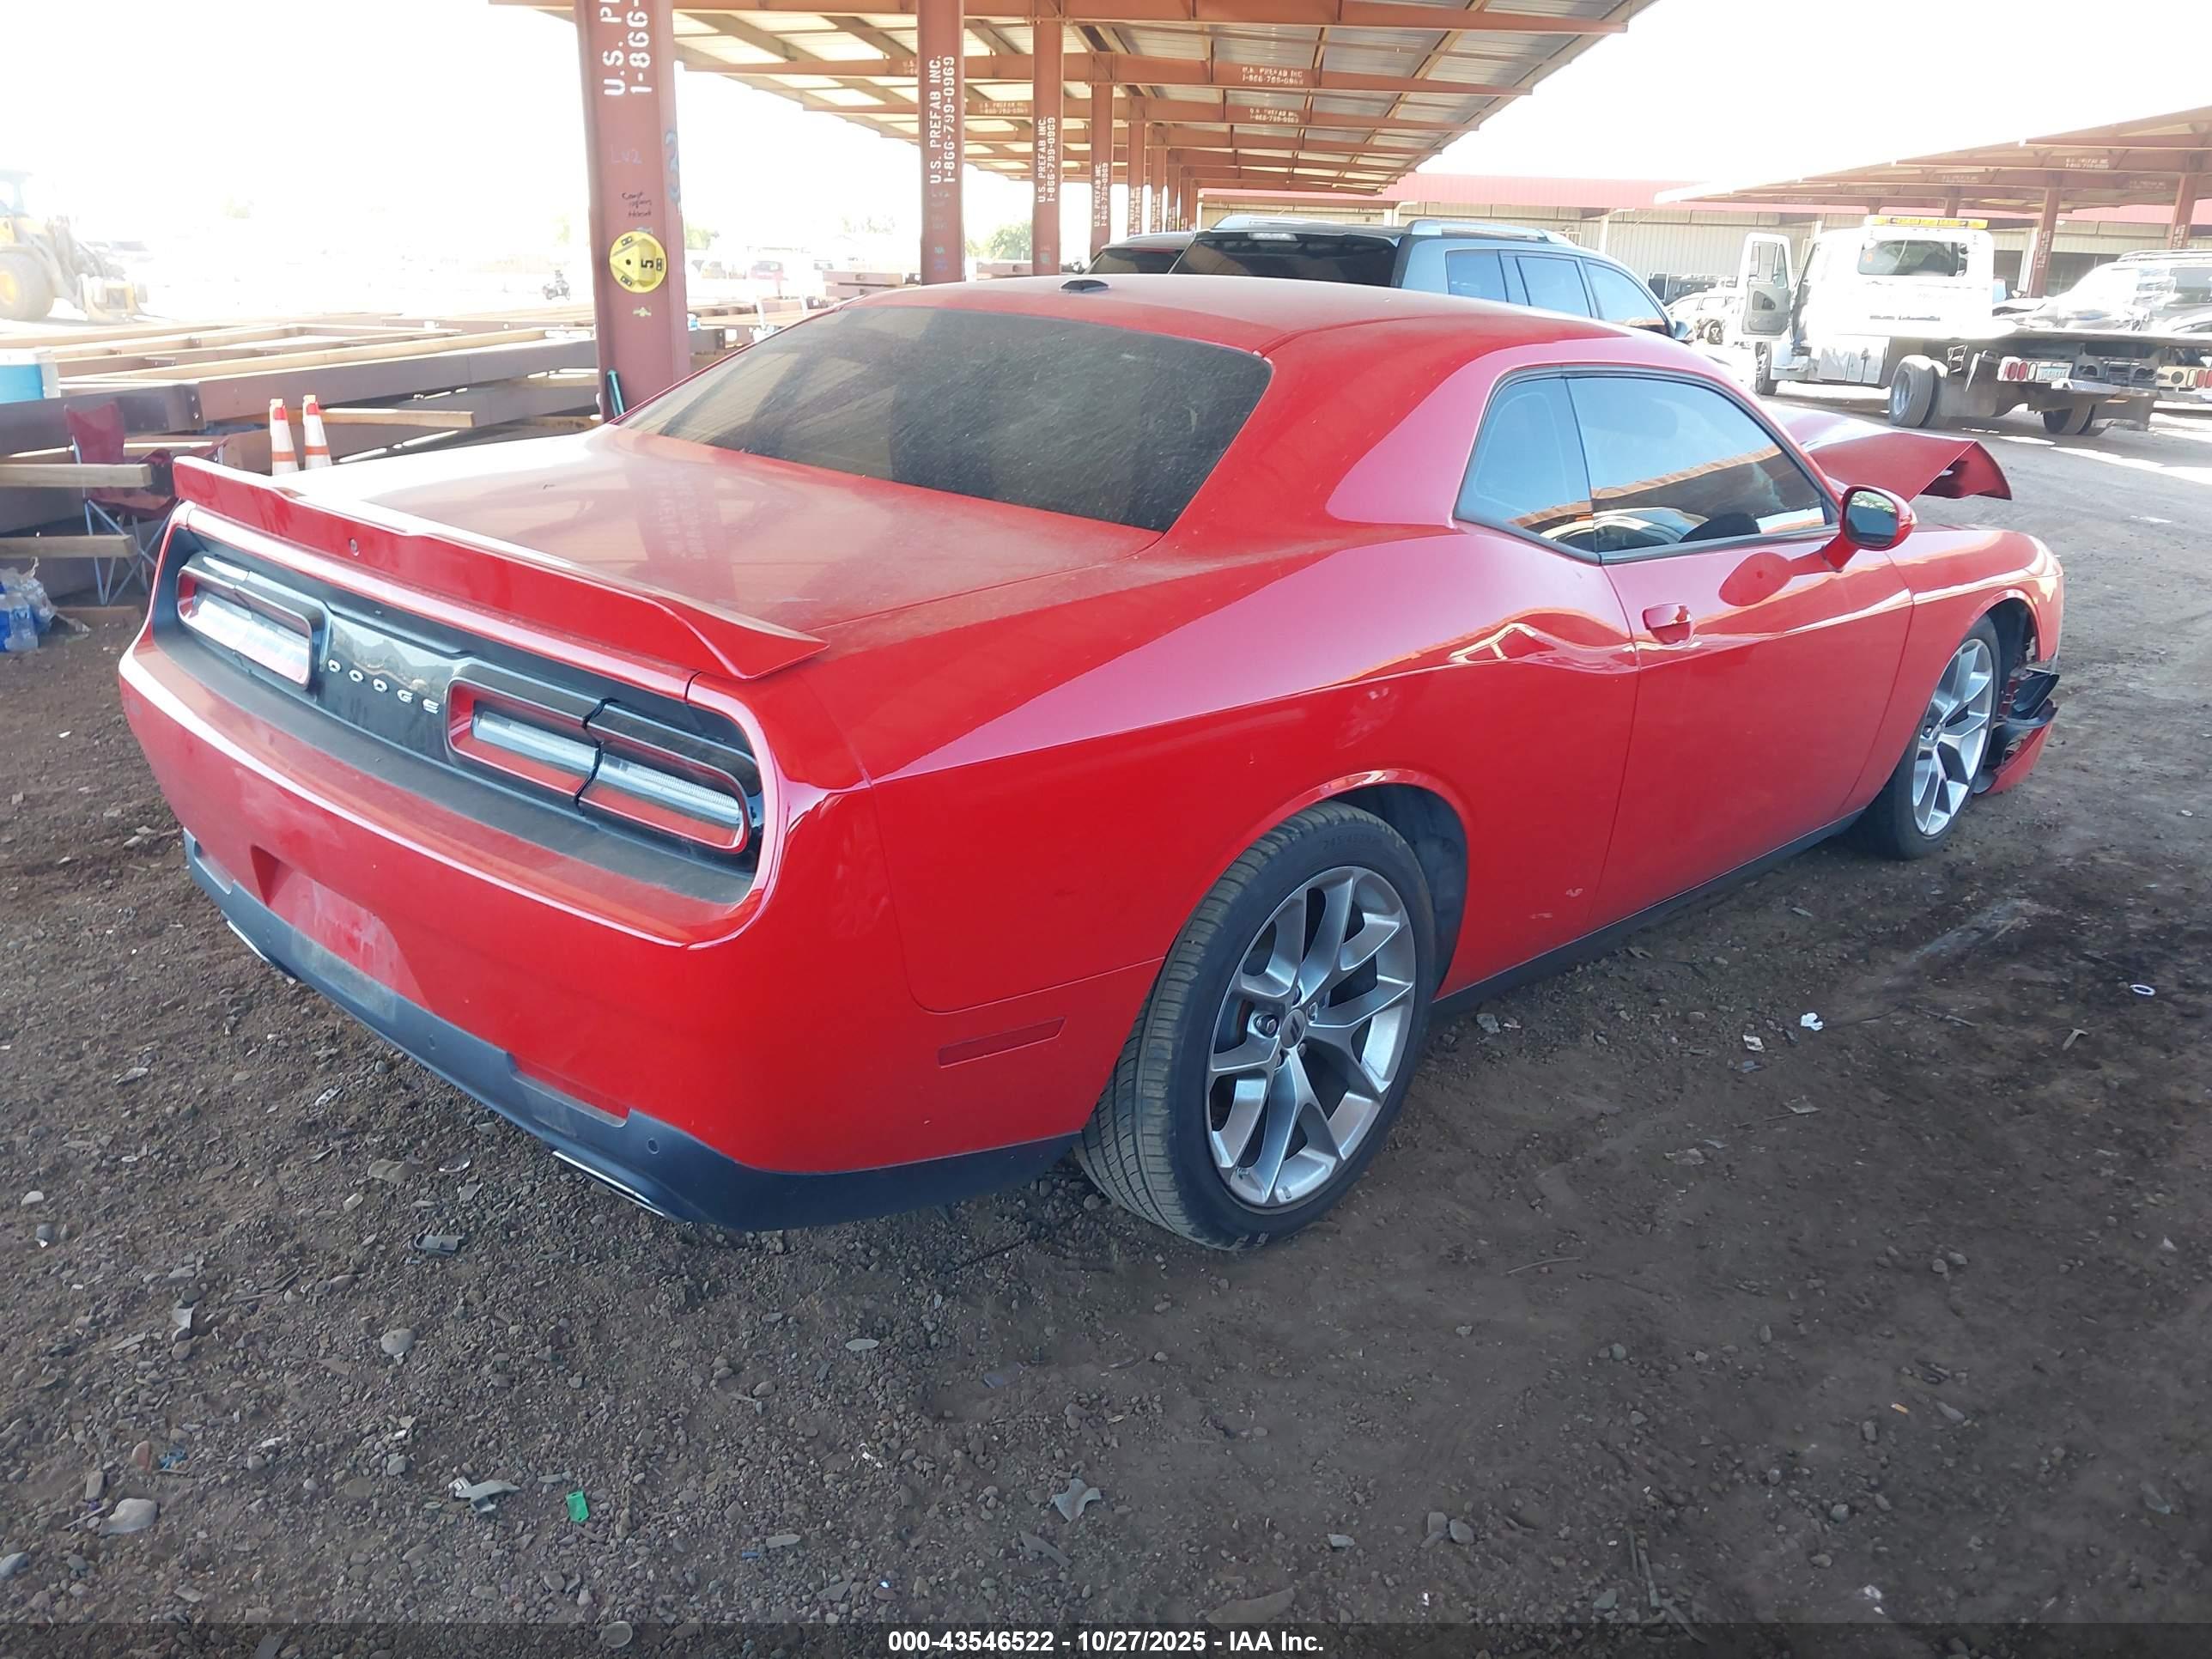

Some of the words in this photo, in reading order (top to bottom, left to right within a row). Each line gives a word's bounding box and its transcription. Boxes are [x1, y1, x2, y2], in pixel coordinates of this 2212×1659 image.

[602, 41, 626, 96] U.S.
[929, 55, 942, 83] INC.
[929, 90, 942, 148] PREFAB
[943, 56, 956, 183] 1-866-799-0969
[1037, 116, 1047, 136] INC.
[929, 155, 942, 185] U.S.
[1037, 139, 1047, 179] PREFAB
[1047, 117, 1056, 203] 1-866-799-0969
[1037, 183, 1047, 203] U.S.
[641, 258, 654, 269] 5
[327, 659, 441, 714] DODGE
